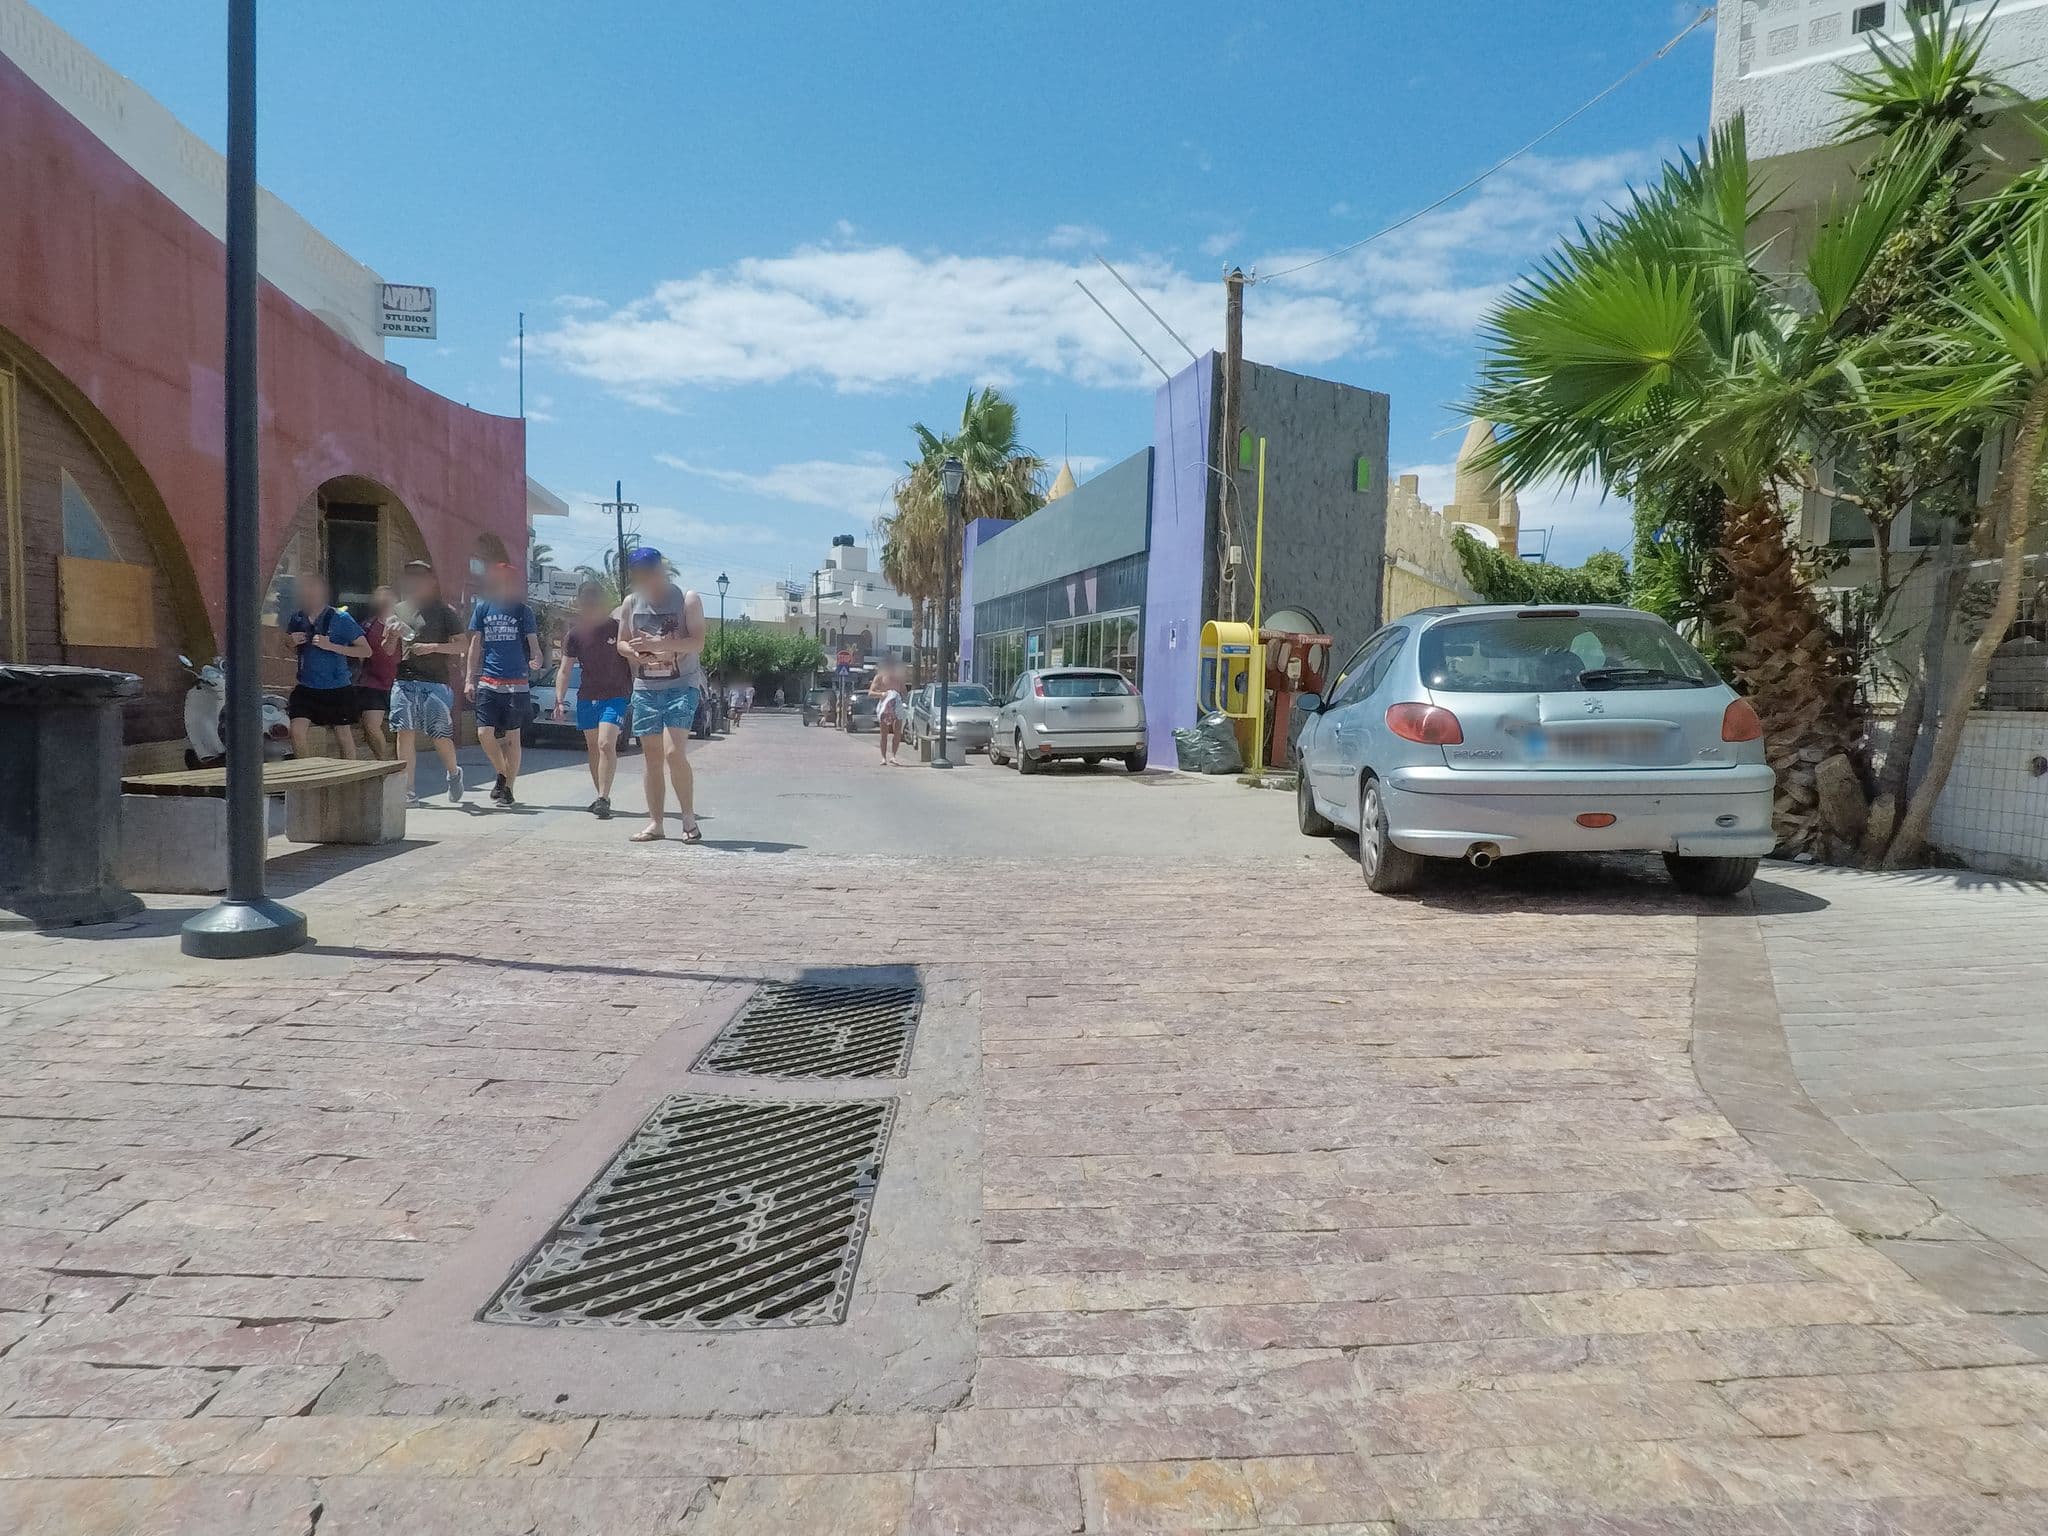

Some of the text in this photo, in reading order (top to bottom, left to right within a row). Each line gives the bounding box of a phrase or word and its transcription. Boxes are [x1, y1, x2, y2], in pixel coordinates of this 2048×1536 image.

[385, 313, 428, 323] STUDIOS
[382, 323, 430, 333] FOR RENT
